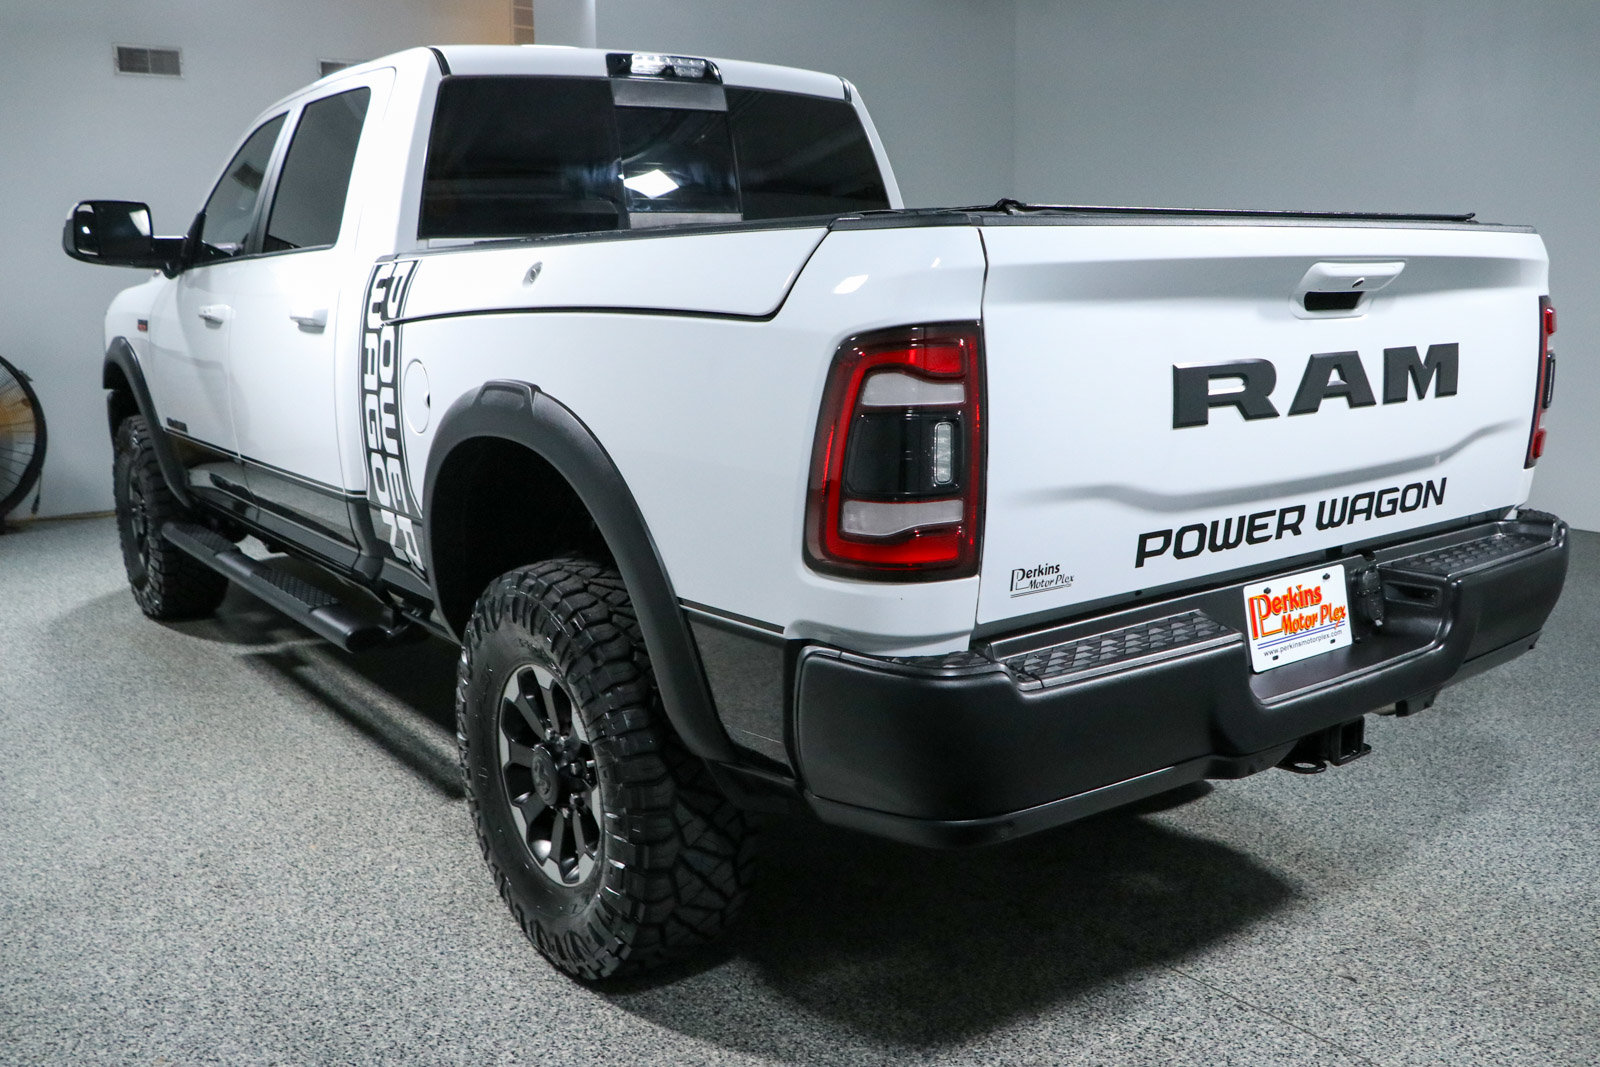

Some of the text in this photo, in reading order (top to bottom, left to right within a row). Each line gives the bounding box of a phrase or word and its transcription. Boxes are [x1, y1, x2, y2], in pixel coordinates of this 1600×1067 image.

[1172, 342, 1459, 429] RAM
[379, 262, 425, 571] POWER
[1135, 477, 1447, 568] POWER WAGON
[1010, 563, 1060, 592] Perkins
[1029, 579, 1054, 589] Motor
[1248, 584, 1323, 640] Perkins
[1281, 602, 1347, 635] Motor Plex
[1263, 630, 1344, 657] www.perkinsmotorplex.com
